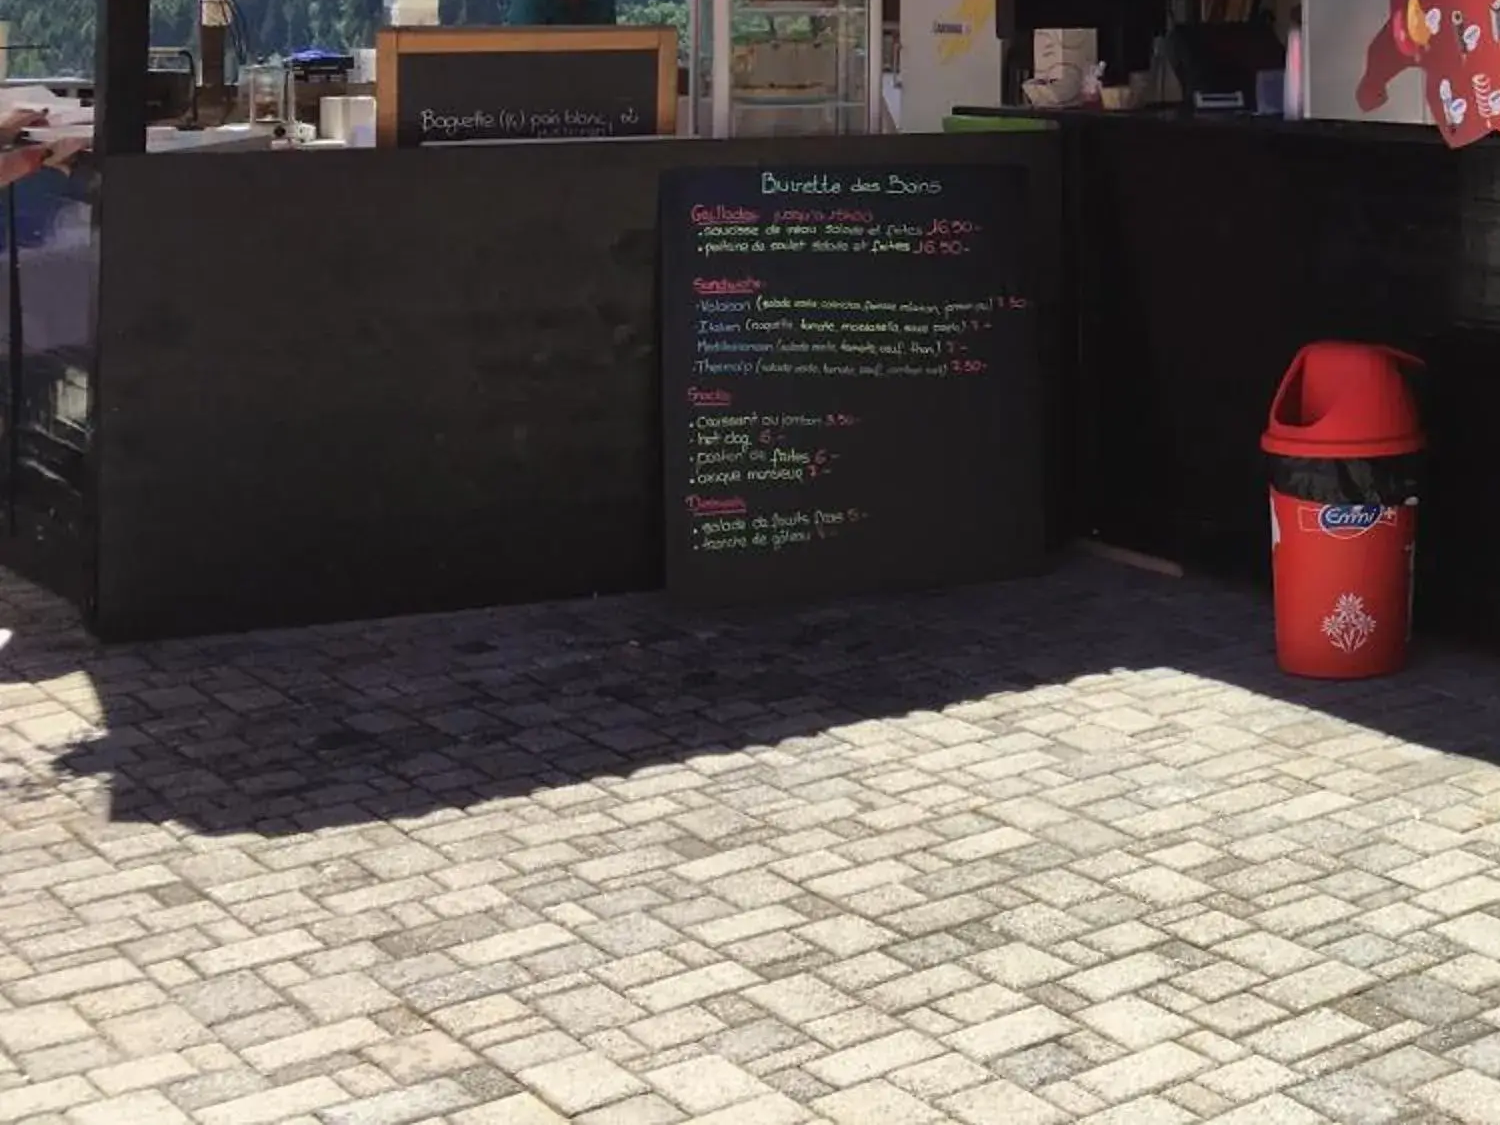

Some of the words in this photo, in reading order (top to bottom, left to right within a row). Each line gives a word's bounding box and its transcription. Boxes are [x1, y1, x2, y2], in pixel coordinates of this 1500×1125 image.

[421, 108, 495, 137] Baguette
[849, 177, 881, 193] des
[765, 224, 781, 235] de
[867, 224, 881, 236] et
[751, 240, 765, 252] de
[853, 239, 867, 253] et
[697, 430, 718, 446] hot
[770, 447, 810, 467] frites
[751, 516, 768, 530] de
[1325, 507, 1378, 525] Emmi
[752, 532, 768, 546] de
